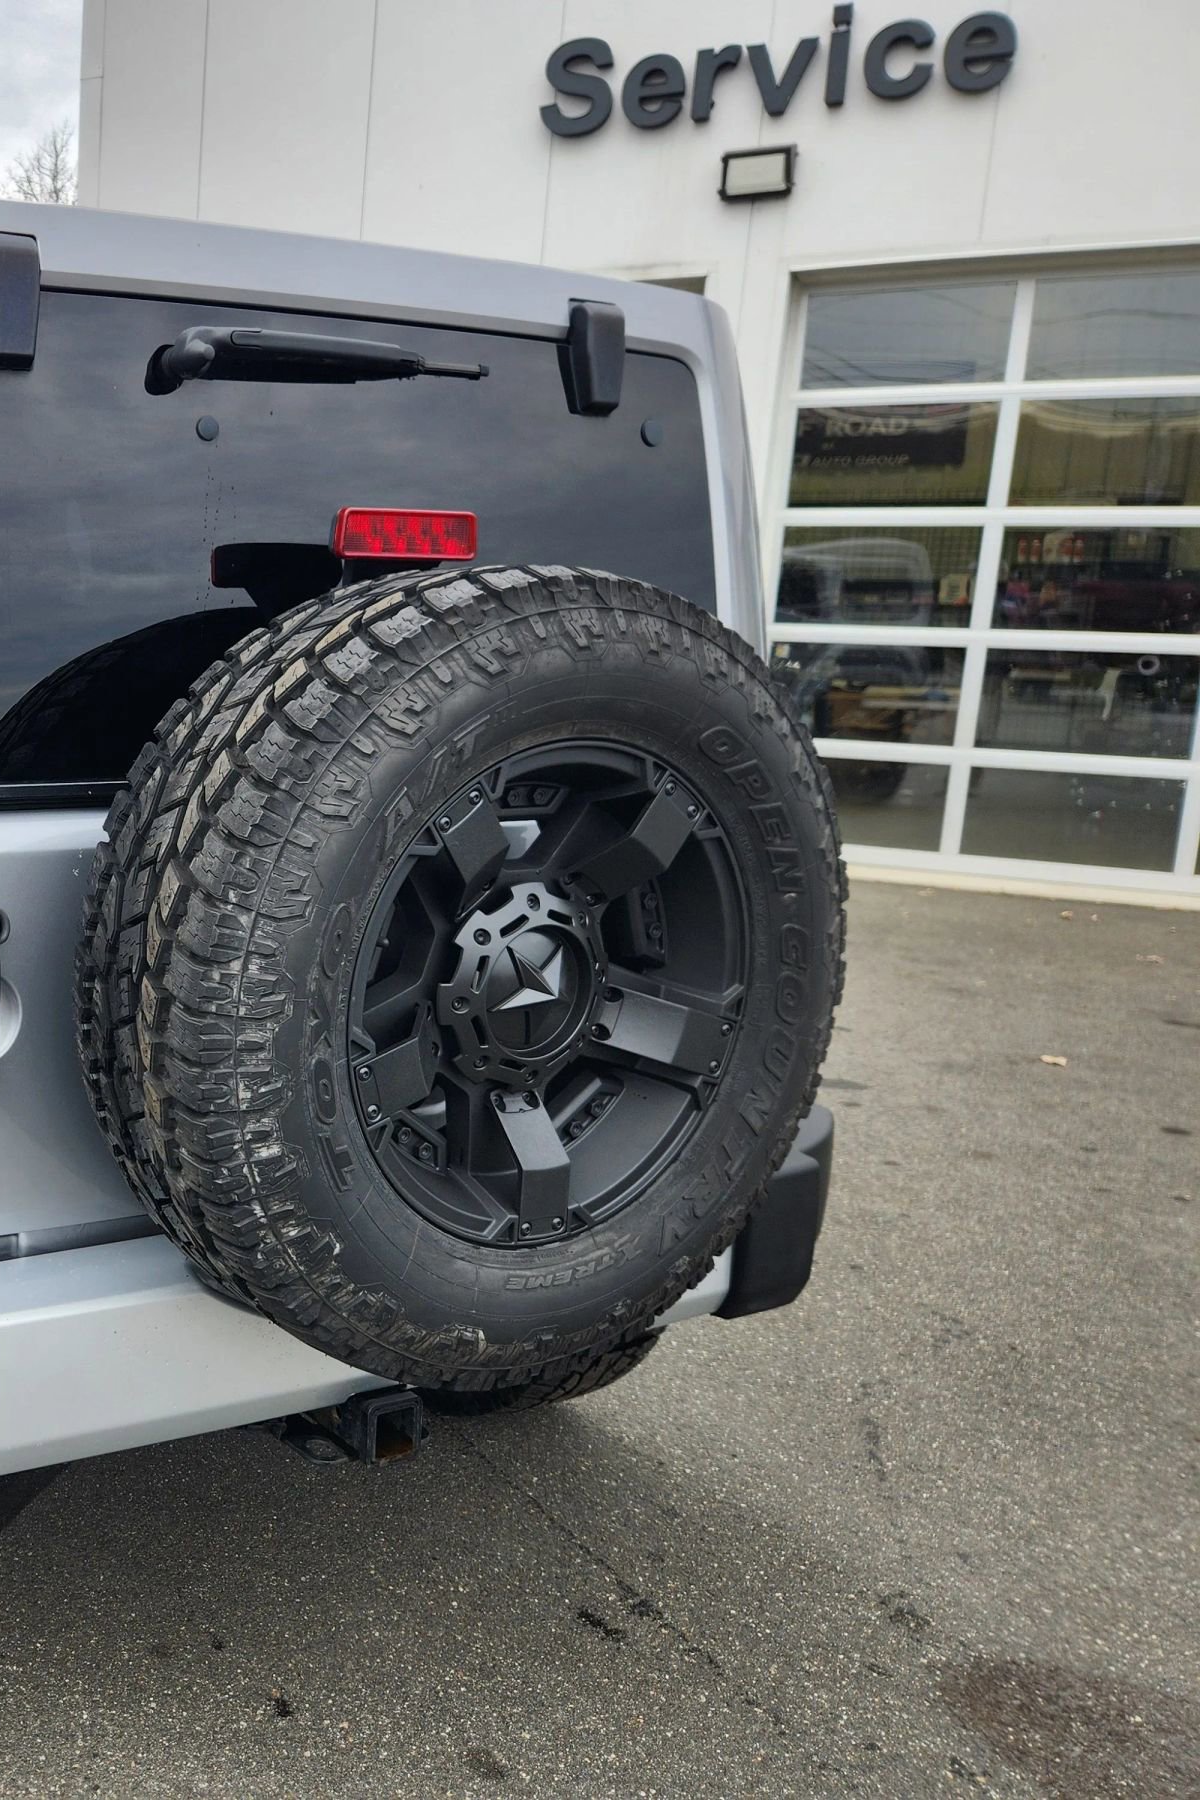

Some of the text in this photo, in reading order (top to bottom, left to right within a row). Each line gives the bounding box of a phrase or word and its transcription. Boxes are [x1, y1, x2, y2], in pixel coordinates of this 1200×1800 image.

[540, 3, 1017, 138] Service
[825, 415, 910, 437] ROAD
[699, 726, 802, 893] OPEN
[304, 902, 355, 1194] TOYO
[657, 921, 810, 1258] COUNTRY
